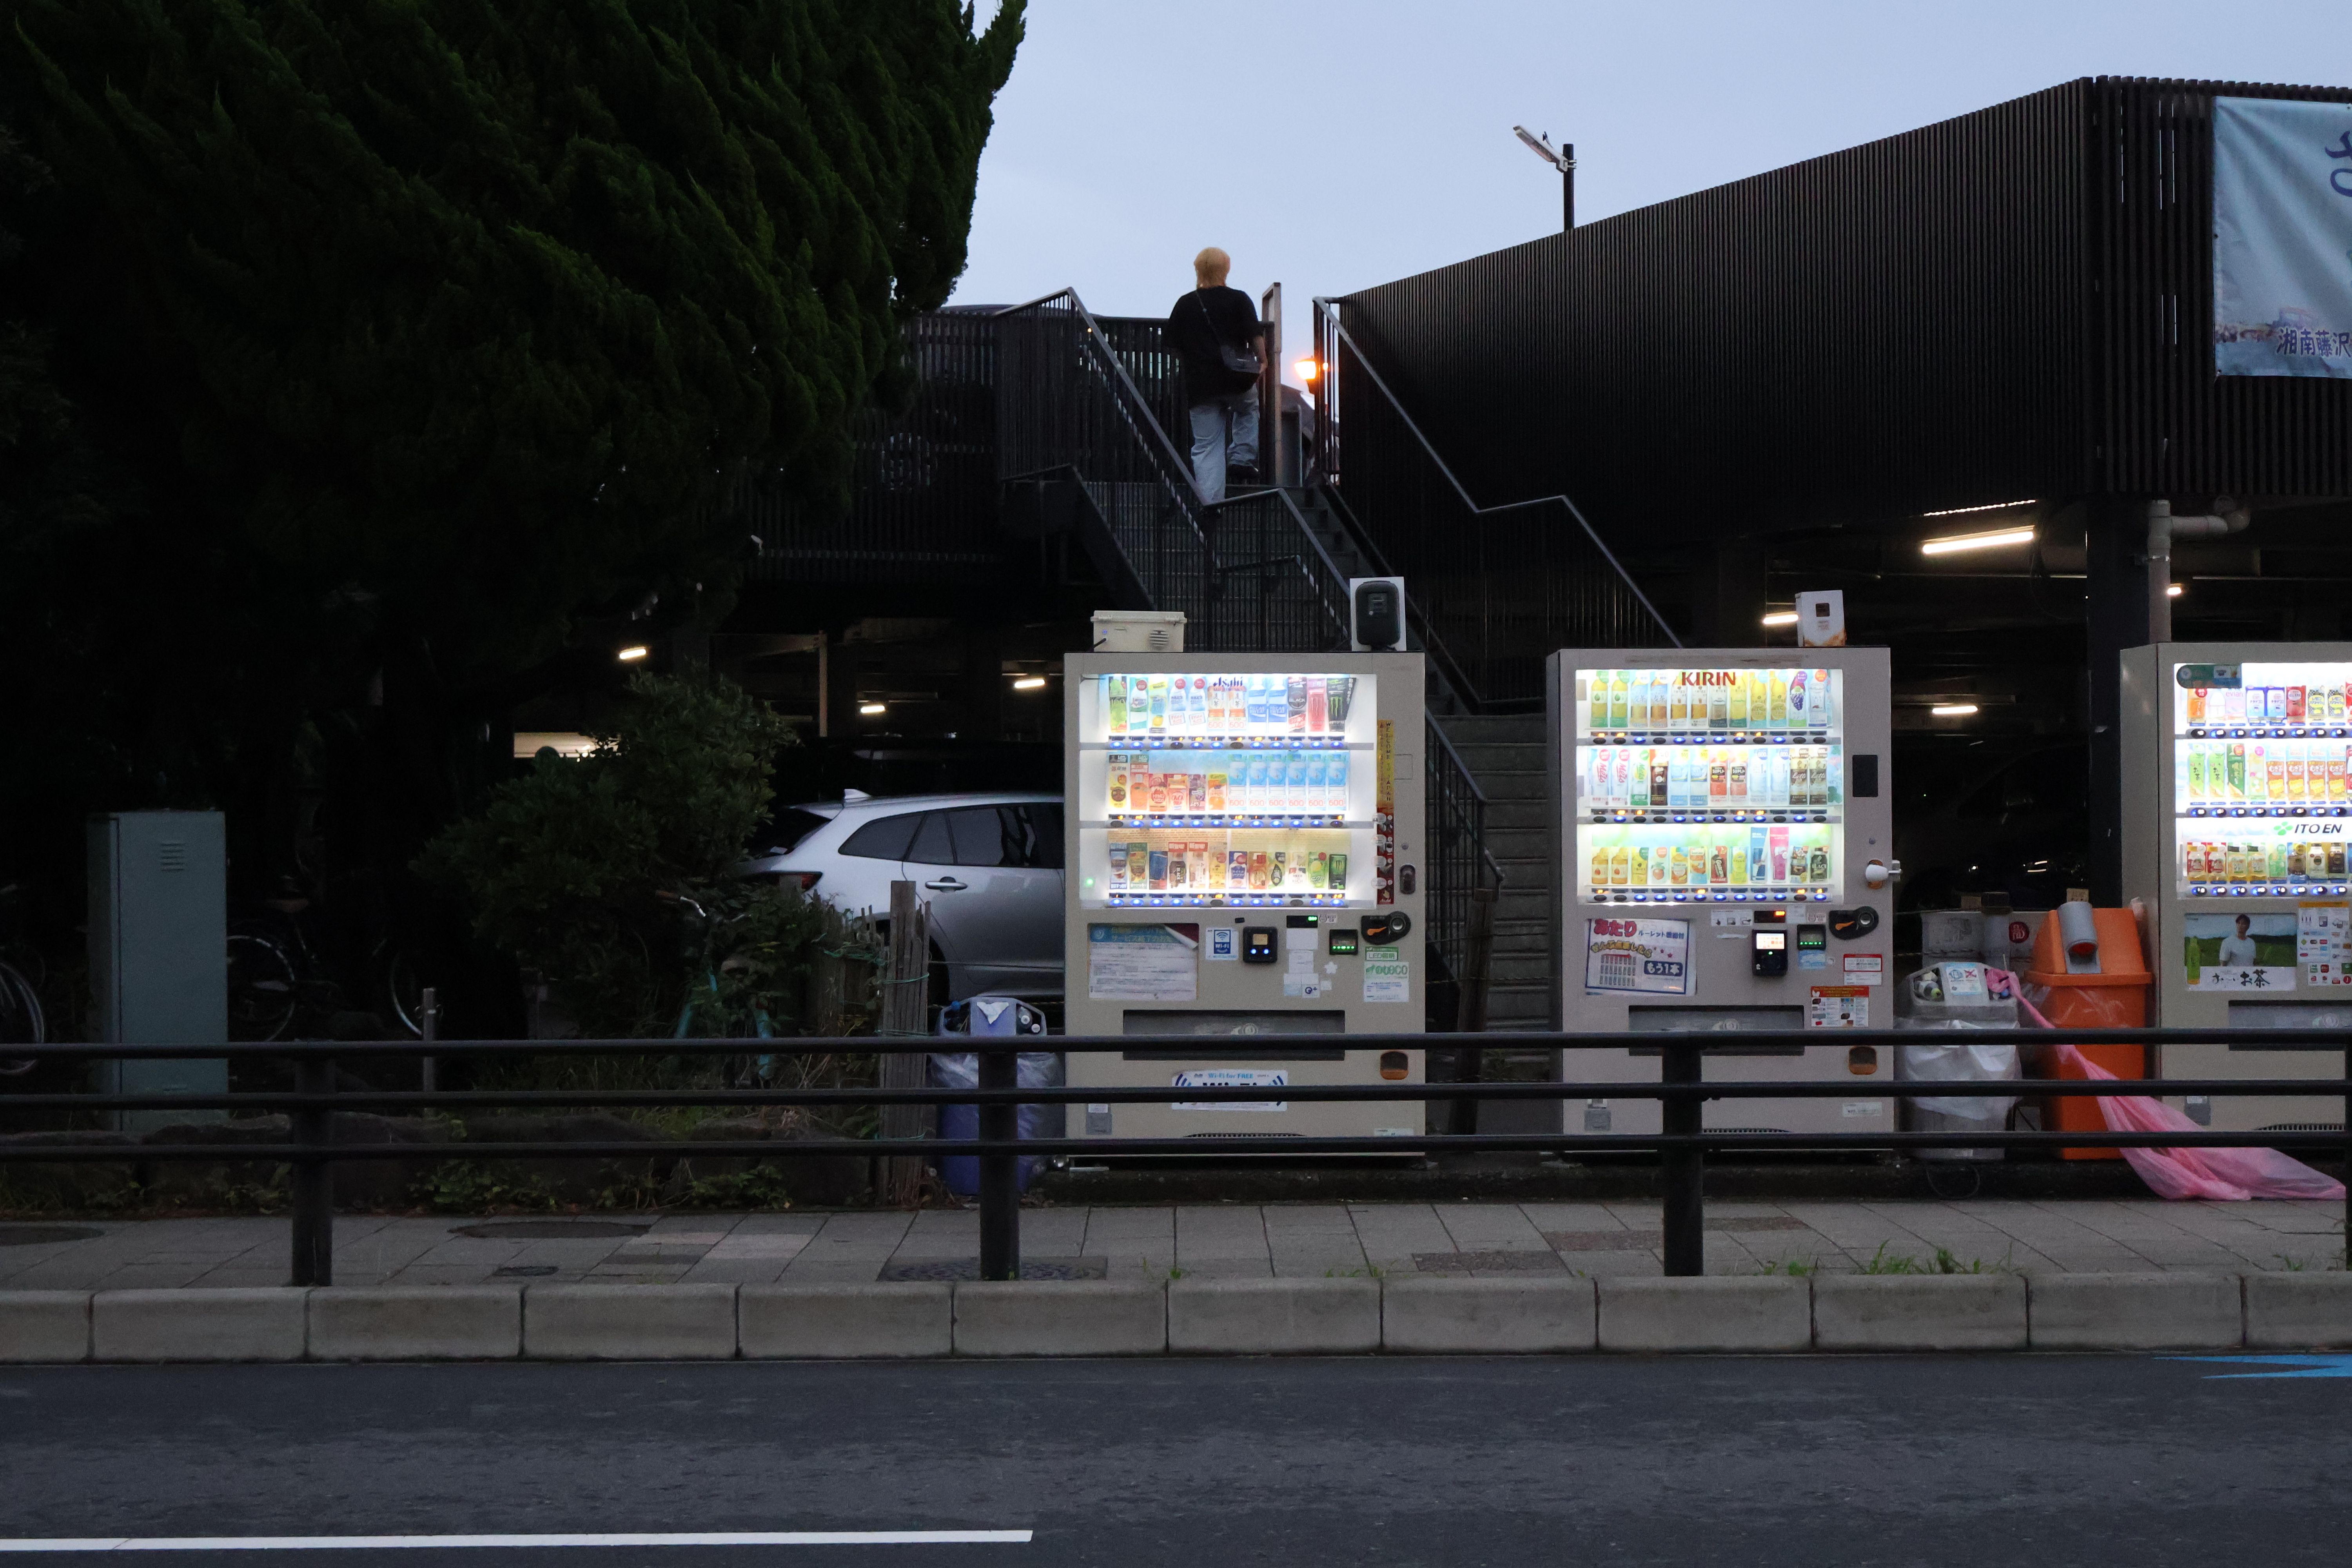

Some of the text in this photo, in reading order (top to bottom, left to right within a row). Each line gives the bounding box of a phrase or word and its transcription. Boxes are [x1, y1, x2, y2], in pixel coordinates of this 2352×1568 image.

[2276, 328, 2351, 358] 湘南藤沢
[1213, 676, 1243, 687] Asahi
[1682, 671, 1736, 686] KIRIN
[1599, 762, 1608, 783] Mets
[1619, 762, 1628, 783] Mets
[2294, 824, 2342, 834] ITO EN
[1593, 918, 1637, 937] あたり
[1647, 962, 1681, 976] もう1本
